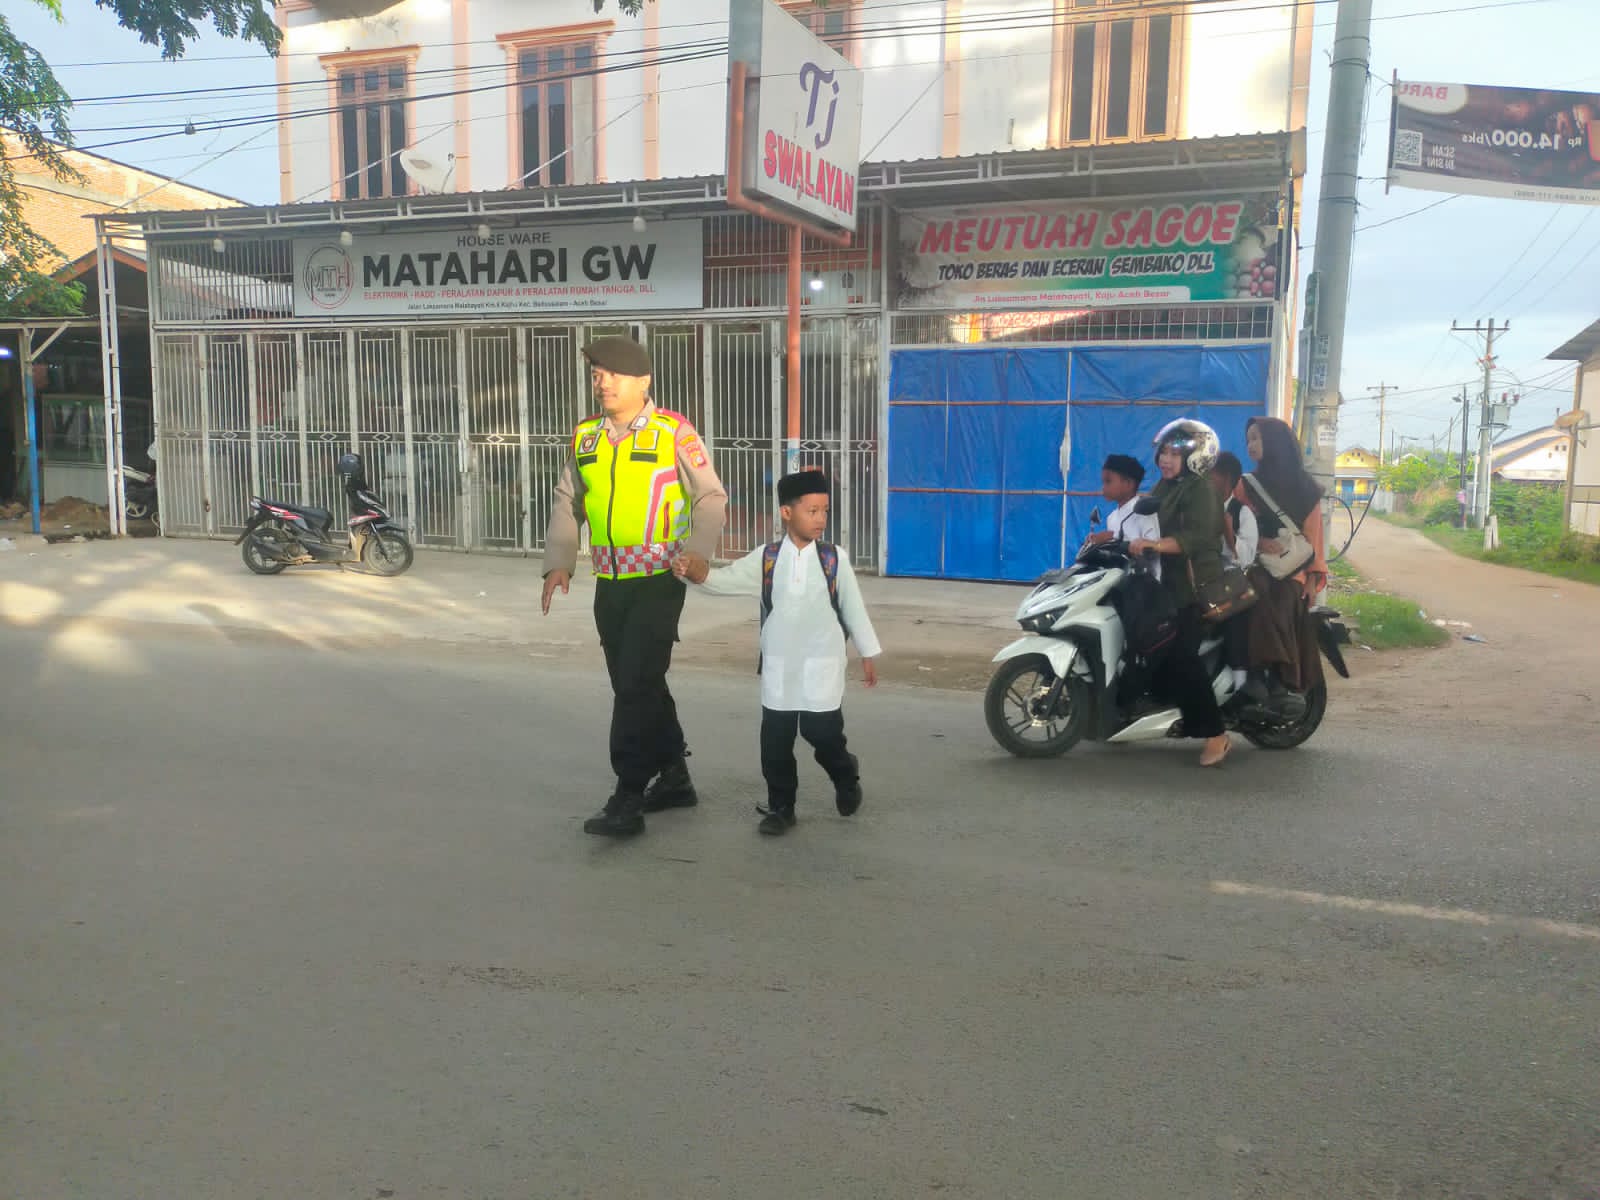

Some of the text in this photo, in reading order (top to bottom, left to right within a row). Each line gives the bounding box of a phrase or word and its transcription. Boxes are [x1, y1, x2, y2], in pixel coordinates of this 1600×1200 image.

[764, 129, 854, 215] SWALAYAN
[509, 232, 552, 244] WARE
[919, 204, 1241, 254] MEUTUAH SAGOE
[363, 243, 656, 288] MATAHARI GW
[938, 252, 1213, 280] TOKO BERAS DAN ECERAN SEMBAKO DLL
[441, 288, 485, 298] PERALATAN
[487, 287, 514, 297] DAPUR
[522, 286, 568, 297] PERALATAN
